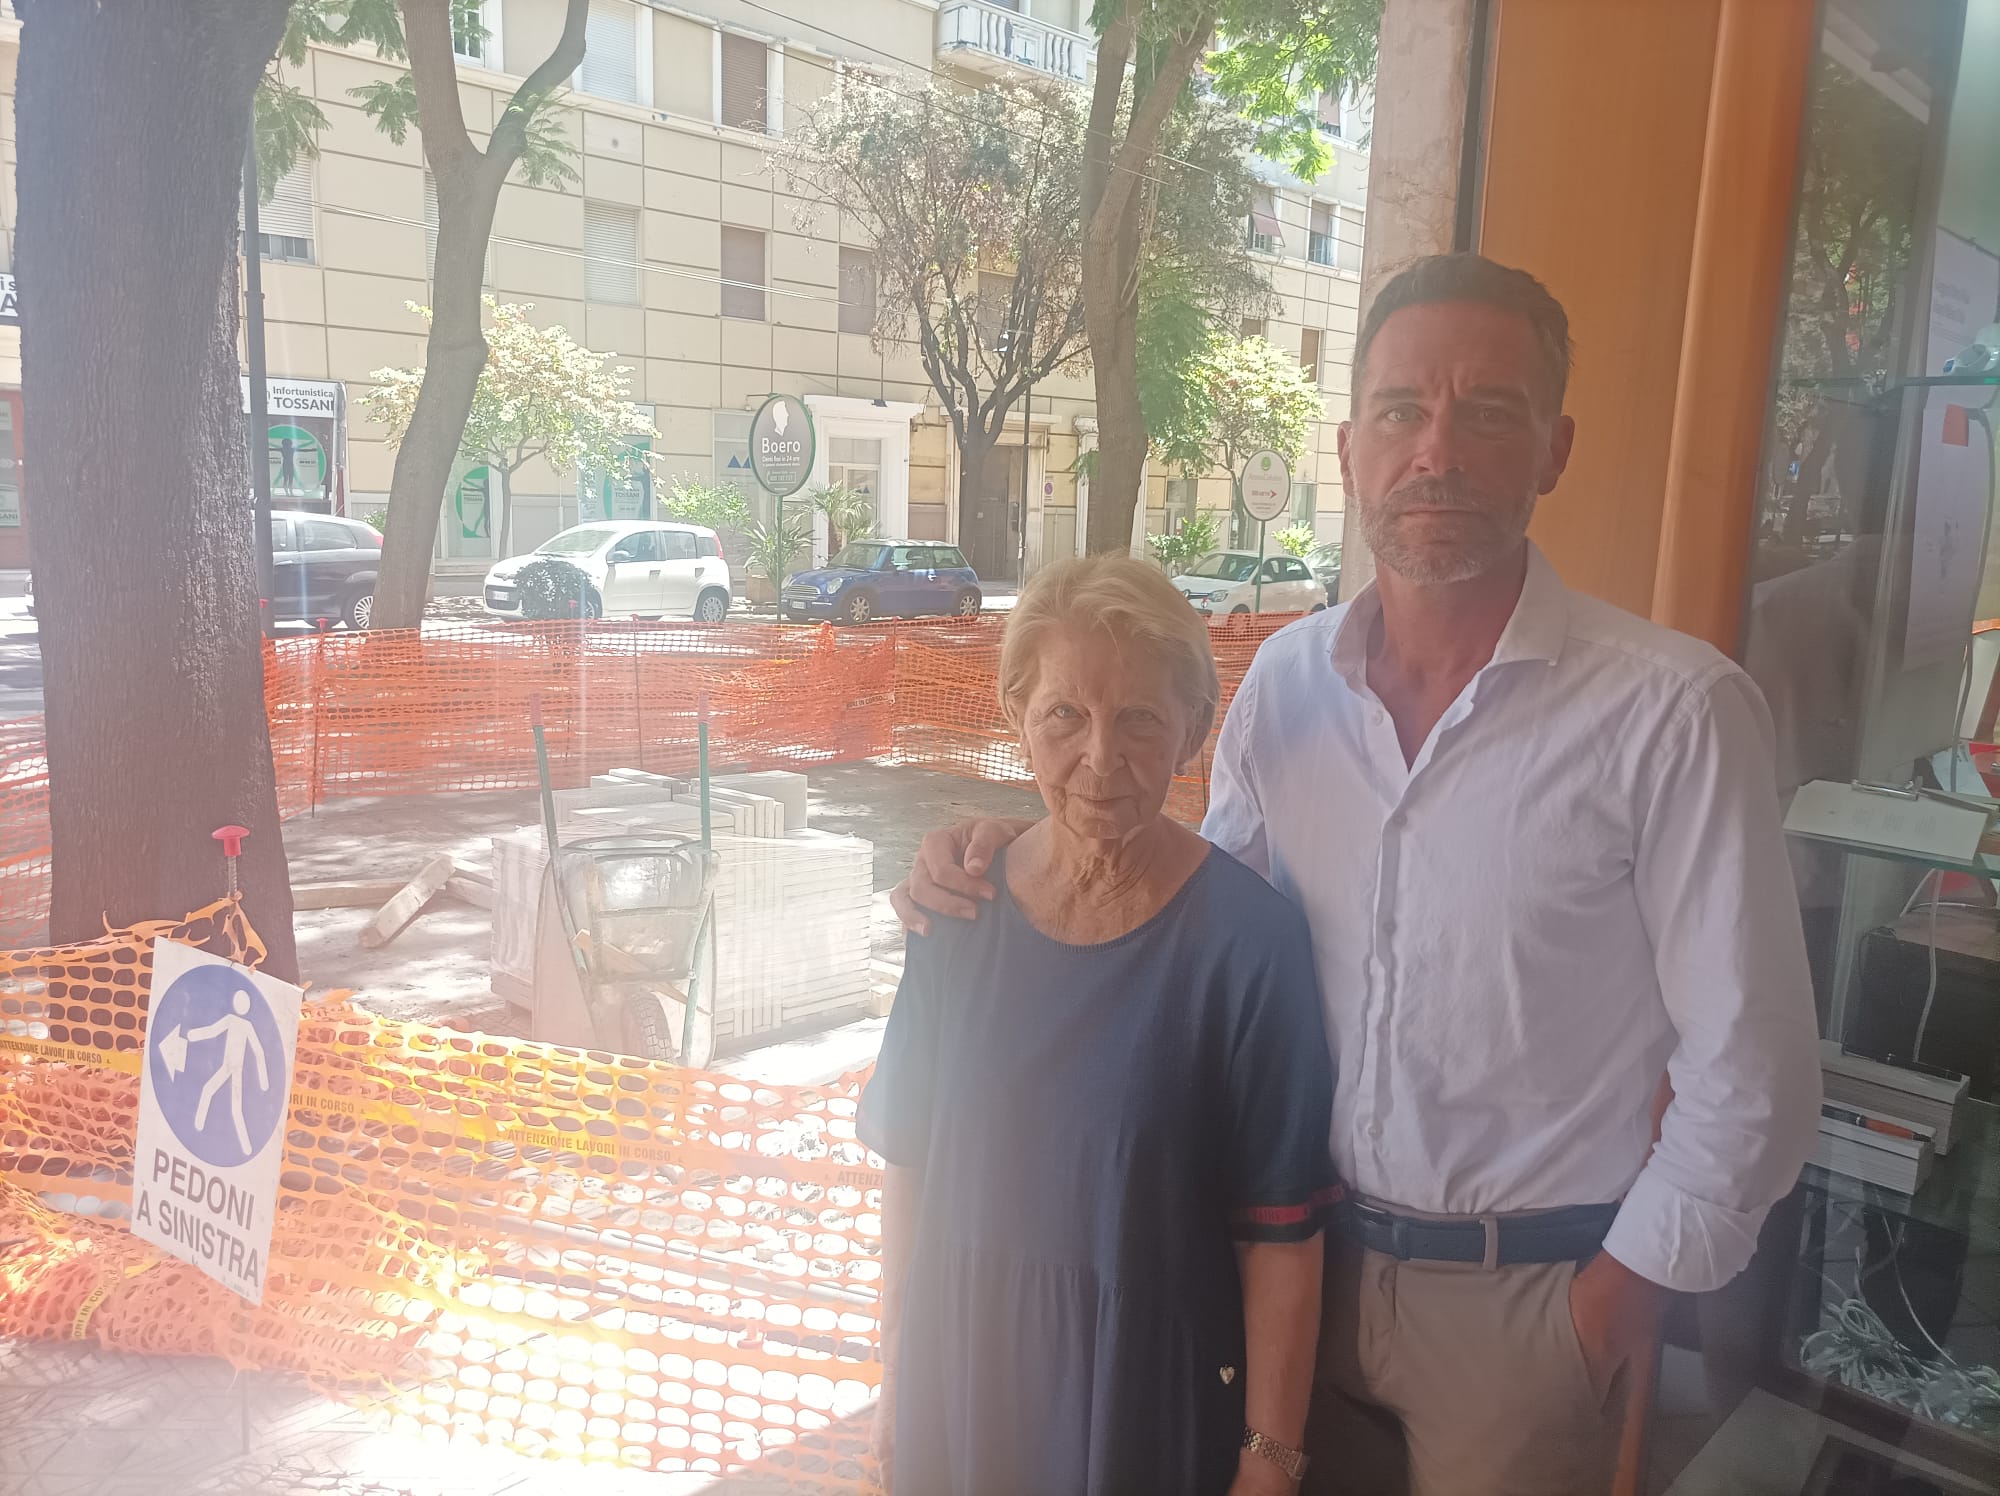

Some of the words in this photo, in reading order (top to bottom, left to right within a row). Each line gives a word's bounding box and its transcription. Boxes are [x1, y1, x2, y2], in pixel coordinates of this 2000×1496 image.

[273, 386, 334, 398] Infortunistica
[273, 396, 334, 411] TOSSANI
[762, 437, 801, 454] Boero
[40, 1046, 65, 1059] LAVORI
[67, 1049, 75, 1060] IN
[77, 1051, 102, 1063] CORSO
[306, 1095, 317, 1107] IN
[320, 1098, 354, 1113] CORSO
[507, 1128, 573, 1149] ATTENZIONE
[576, 1139, 615, 1155] LAVORI
[619, 1145, 631, 1157] IN
[634, 1147, 671, 1162] CORSO
[153, 1147, 255, 1231] PEDONI
[136, 1190, 151, 1227] A
[158, 1198, 259, 1288] SINISTRA
